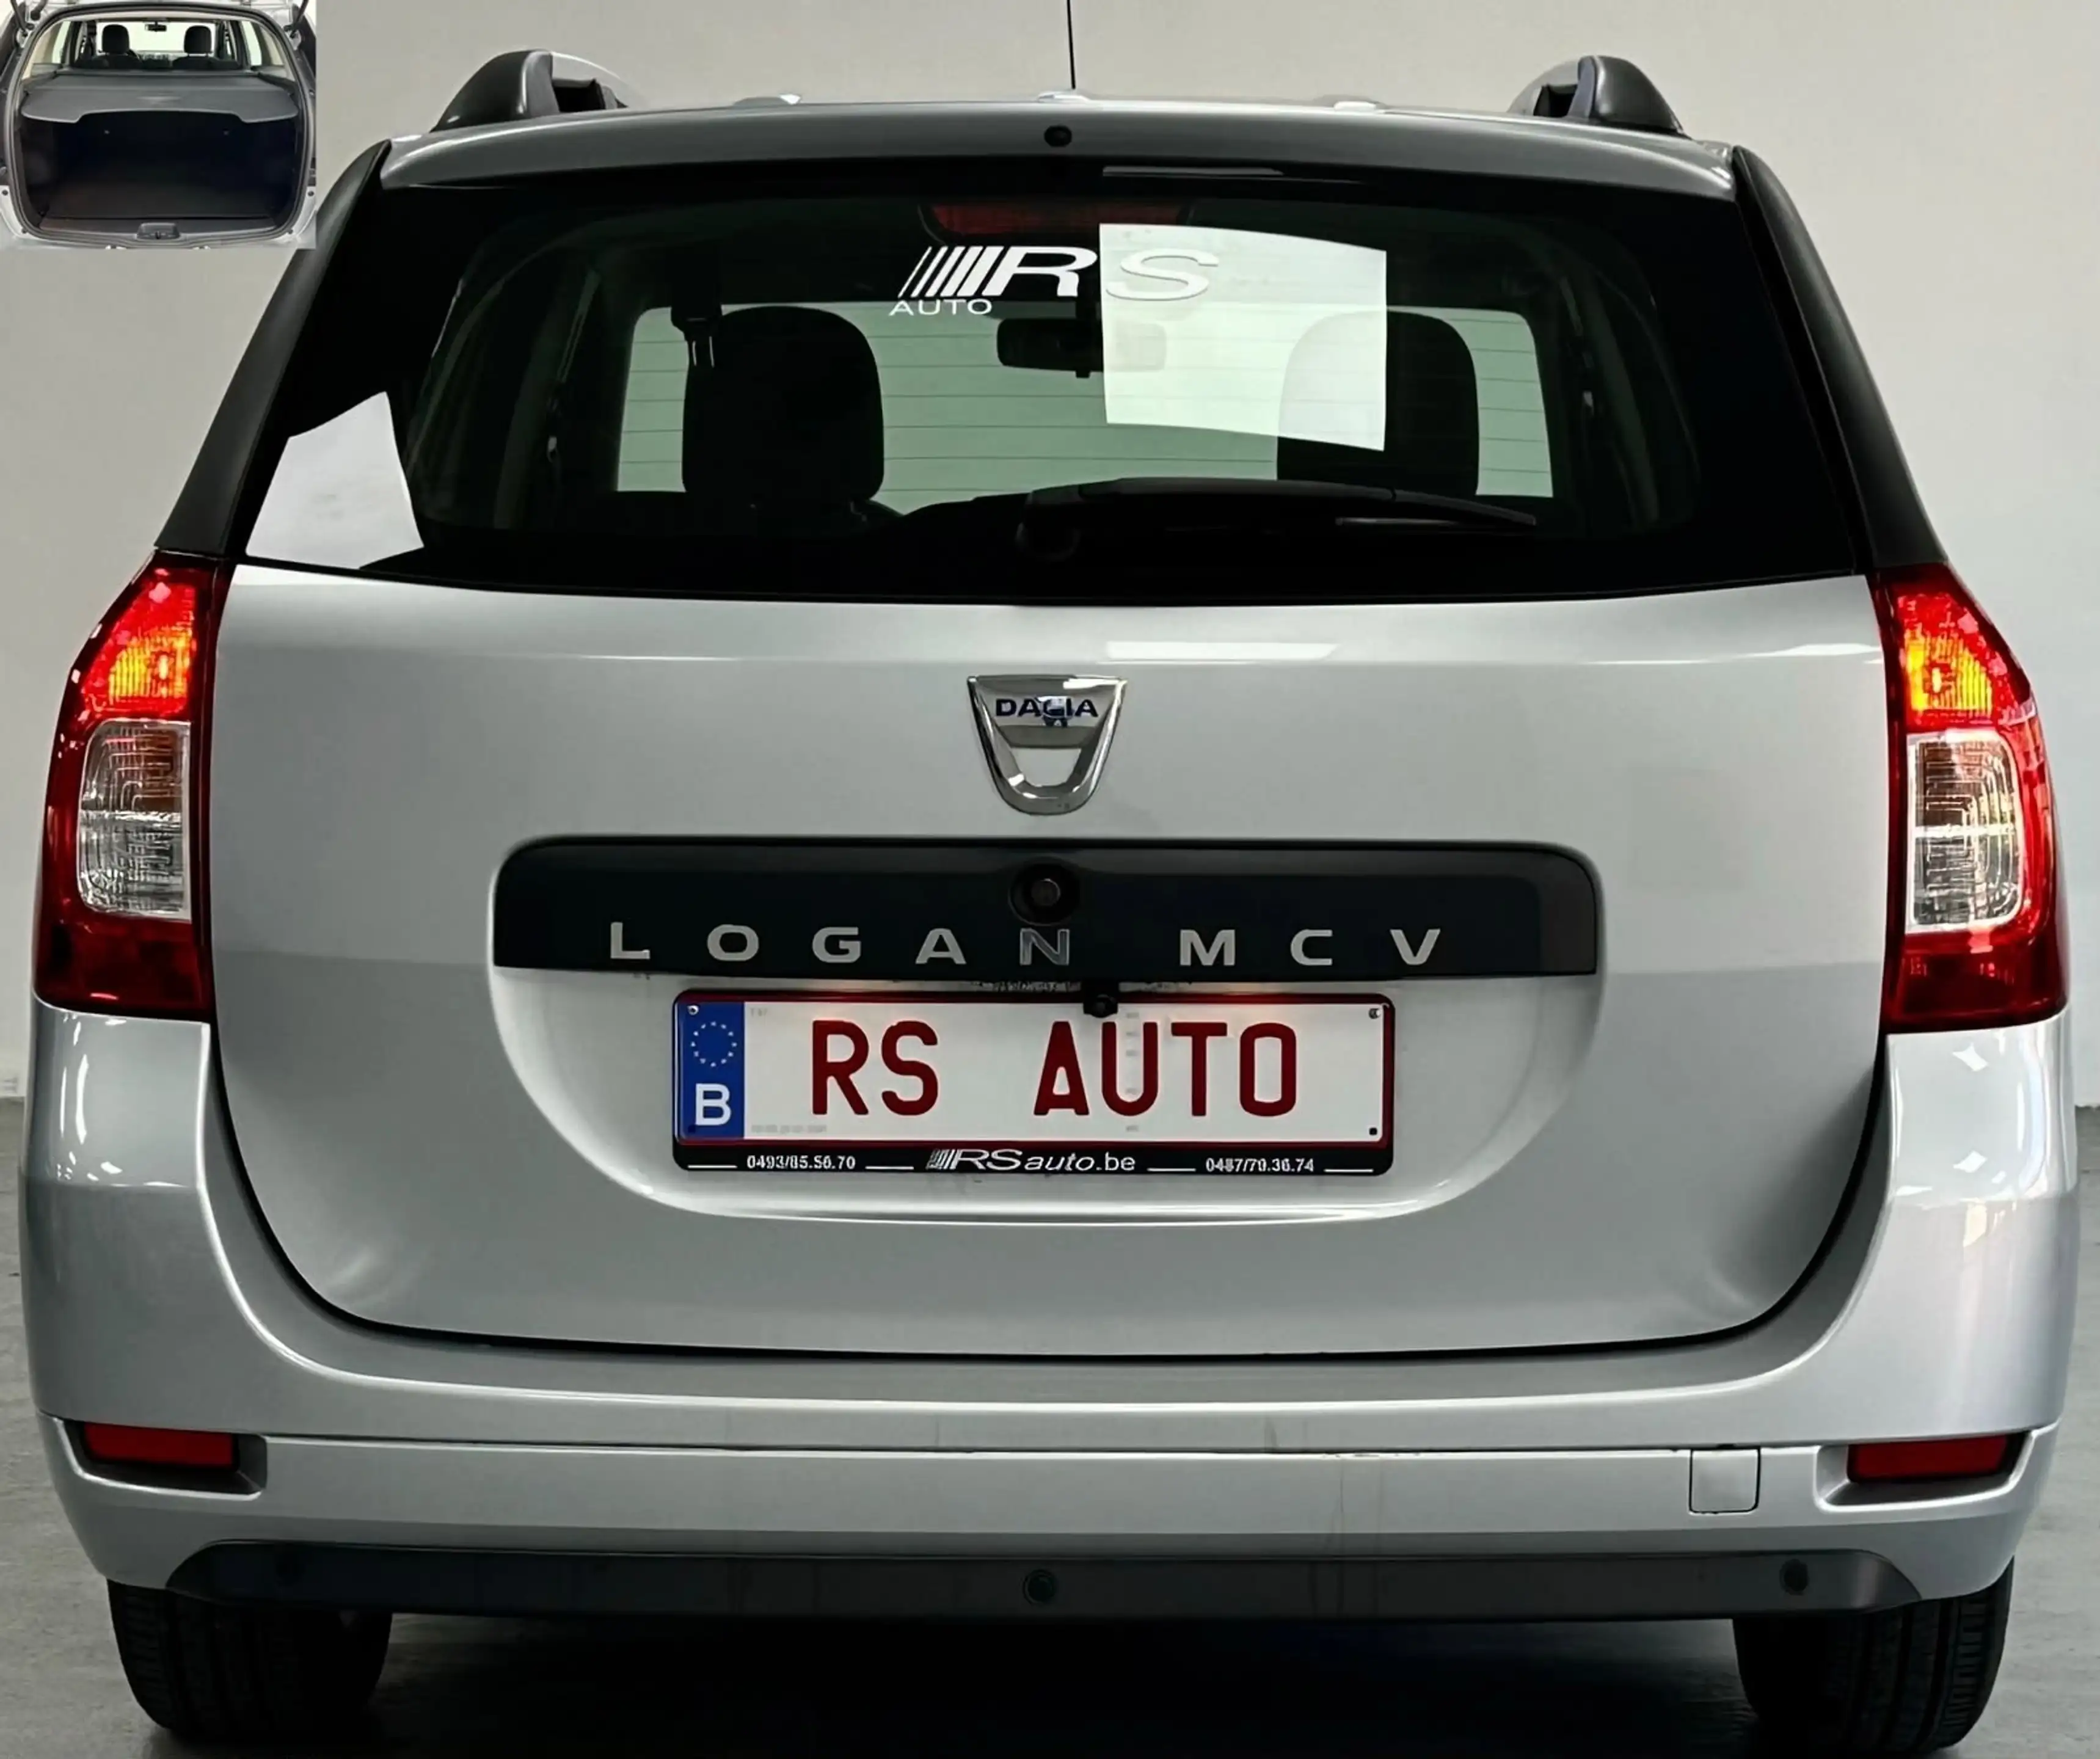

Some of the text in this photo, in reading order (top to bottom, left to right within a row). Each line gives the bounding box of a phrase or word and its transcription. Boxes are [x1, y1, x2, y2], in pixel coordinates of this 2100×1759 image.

[889, 298, 993, 316] AUTO
[610, 921, 1441, 966] LOGAN MCV
[812, 1019, 1297, 1117] RS AUTO
[695, 1083, 732, 1126] B
